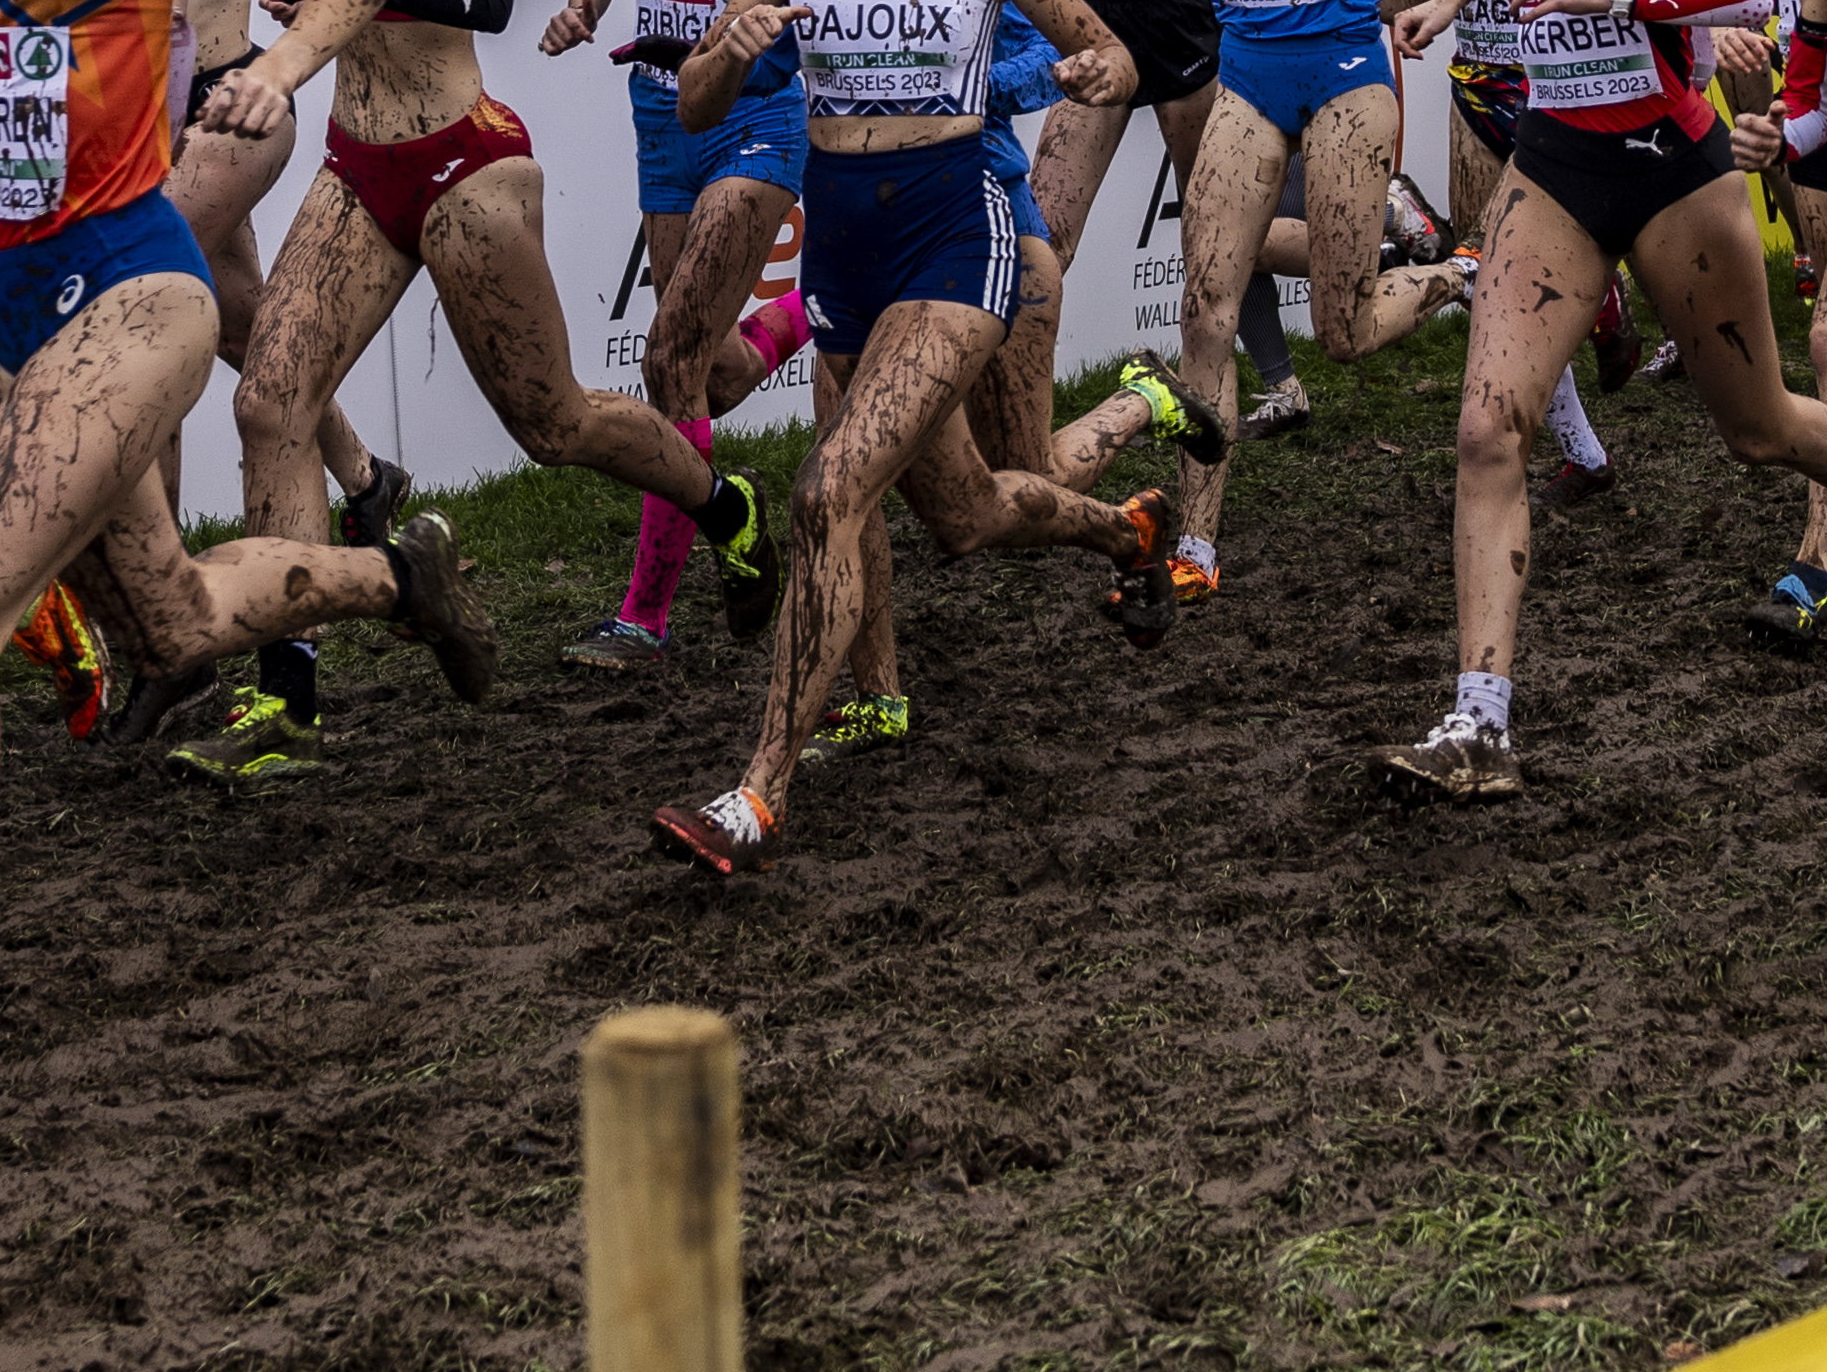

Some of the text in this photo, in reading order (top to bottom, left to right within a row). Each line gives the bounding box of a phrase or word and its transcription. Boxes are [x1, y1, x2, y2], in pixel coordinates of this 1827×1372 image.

[636, 6, 719, 40] RIBIGI
[796, 3, 953, 42] DAJOUX
[1521, 14, 1643, 56] KERBER
[832, 54, 865, 67] RUN
[816, 71, 942, 92] BRUSSELS 2023
[1536, 75, 1651, 101] BRUSSELS 2023
